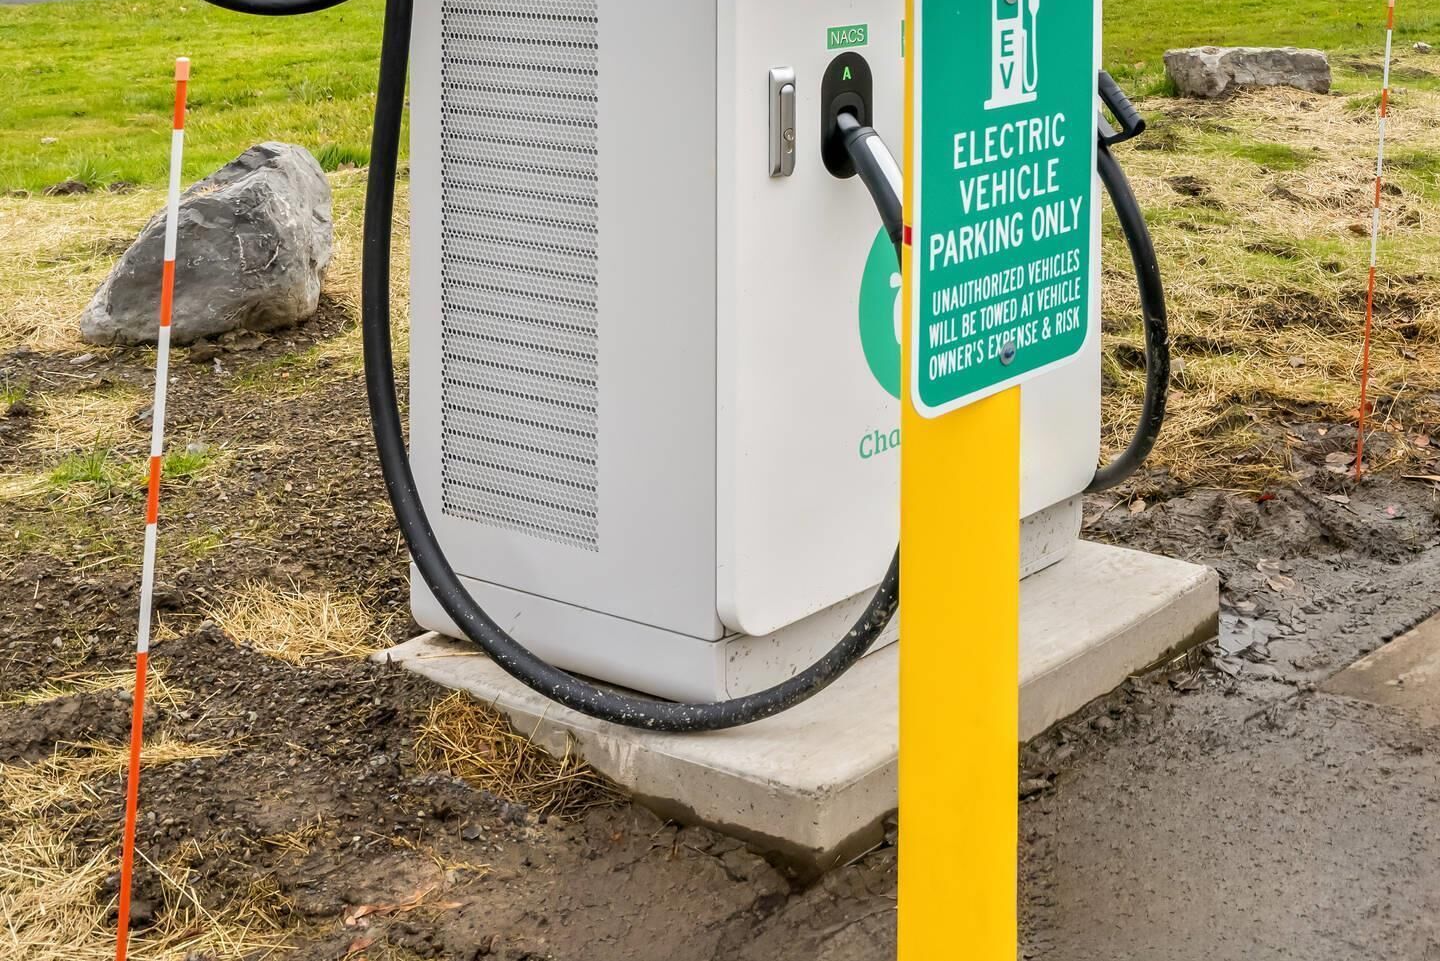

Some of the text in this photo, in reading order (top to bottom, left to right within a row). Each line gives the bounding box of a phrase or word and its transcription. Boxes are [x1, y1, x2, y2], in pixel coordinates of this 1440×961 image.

[831, 28, 865, 46] NACS
[1000, 29, 1015, 90] EV
[842, 66, 851, 80] A
[953, 112, 1065, 170] ELECTRIC
[959, 158, 1060, 215] VEHICLE
[929, 196, 1083, 271] PARKING ONLY
[932, 248, 1080, 316] UNAUTHORIZED VEHICLES
[929, 277, 1081, 349] WILL BE TOWED AT VEHICLE
[929, 339, 984, 381] OWNER'S
[1042, 316, 1051, 340] &
[1055, 306, 1080, 336] RISK
